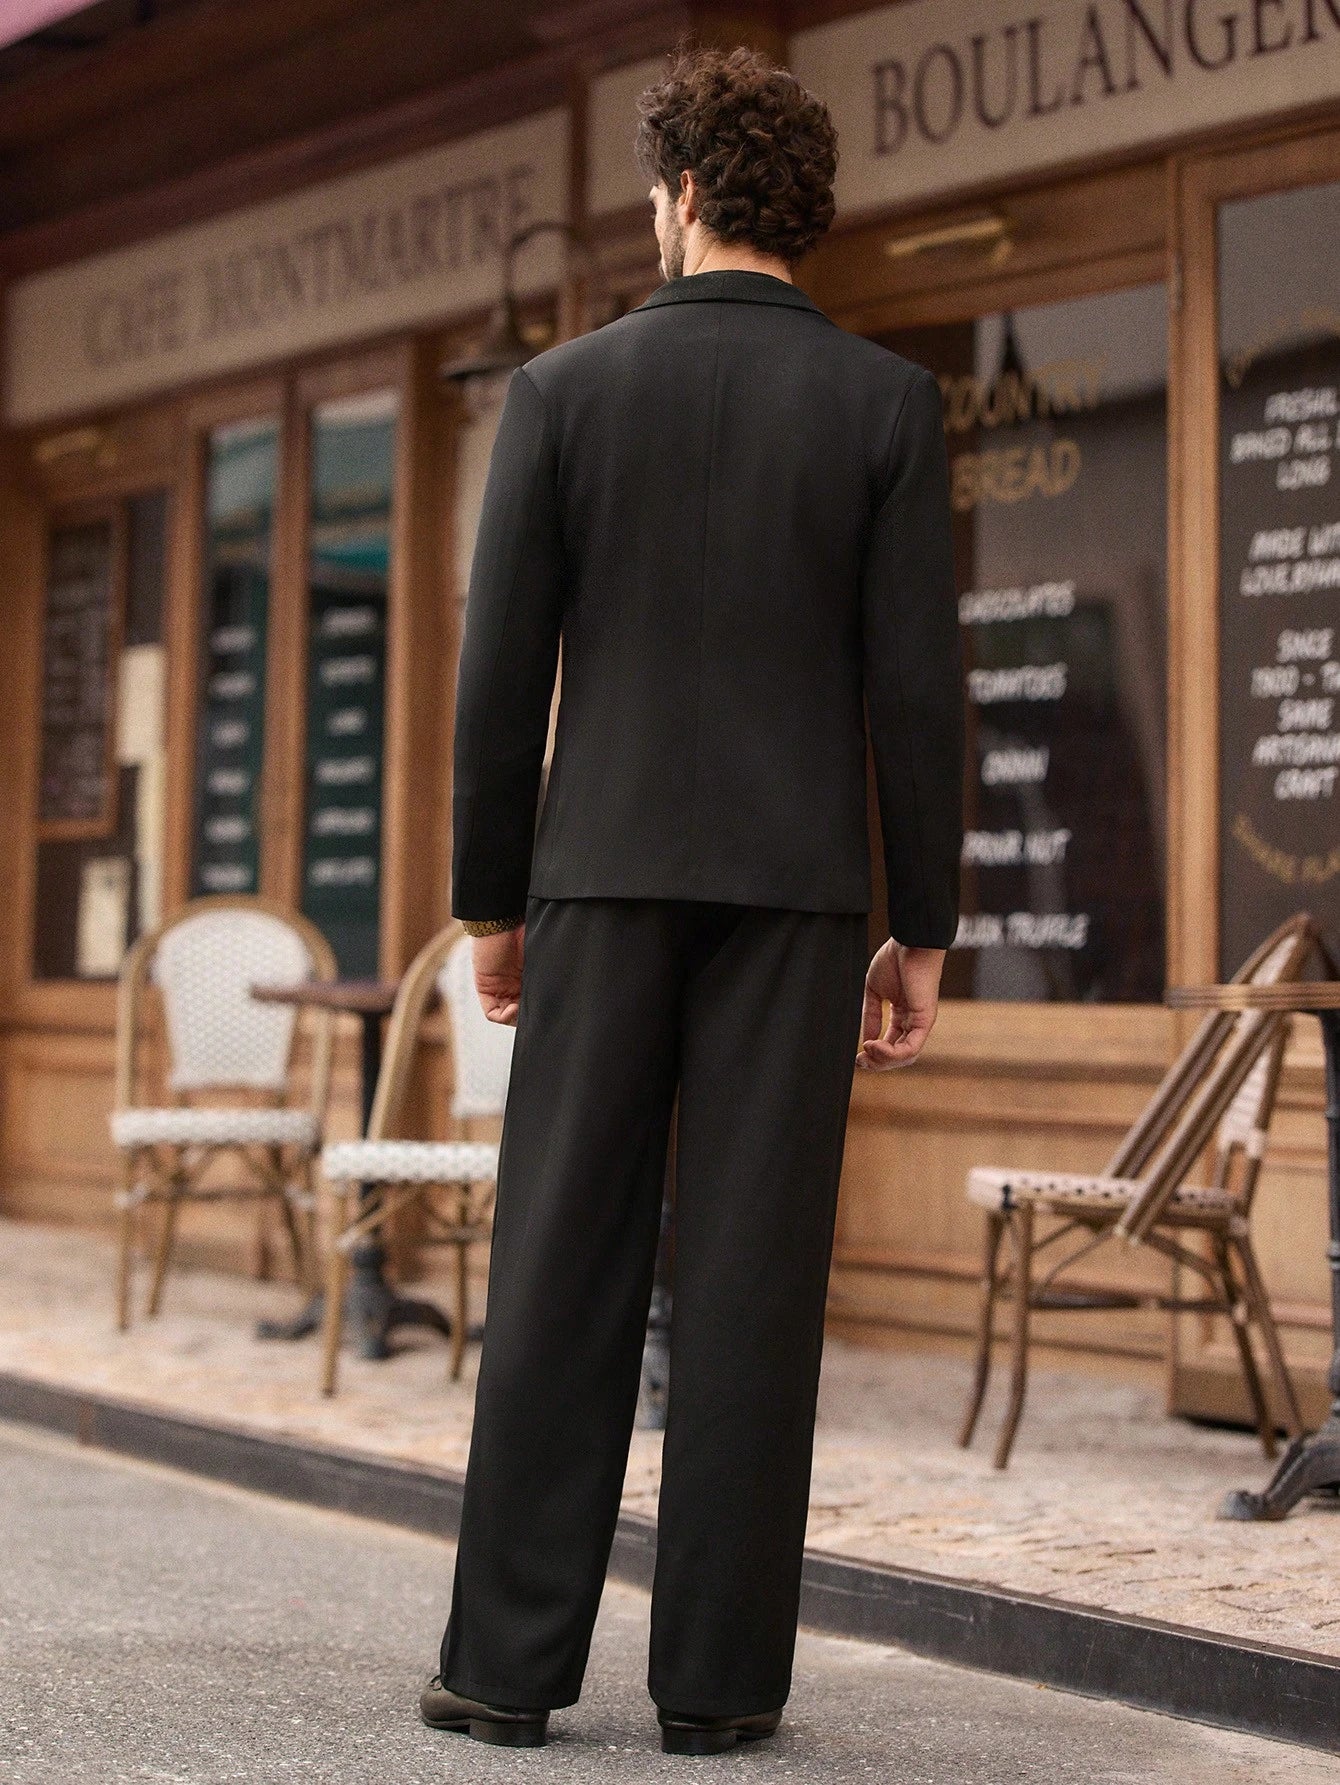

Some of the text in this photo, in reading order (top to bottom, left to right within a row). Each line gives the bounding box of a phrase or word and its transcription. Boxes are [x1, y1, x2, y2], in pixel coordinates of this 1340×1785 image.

[206, 164, 533, 336] MONTMARTRE
[952, 438, 1080, 510] BREAD
[959, 581, 1074, 624] CHOCOLATES
[1276, 628, 1334, 663] SINCE
[967, 662, 1067, 704] TOMATOES
[1276, 697, 1334, 732] SAME
[1273, 766, 1337, 800] CRAFT
